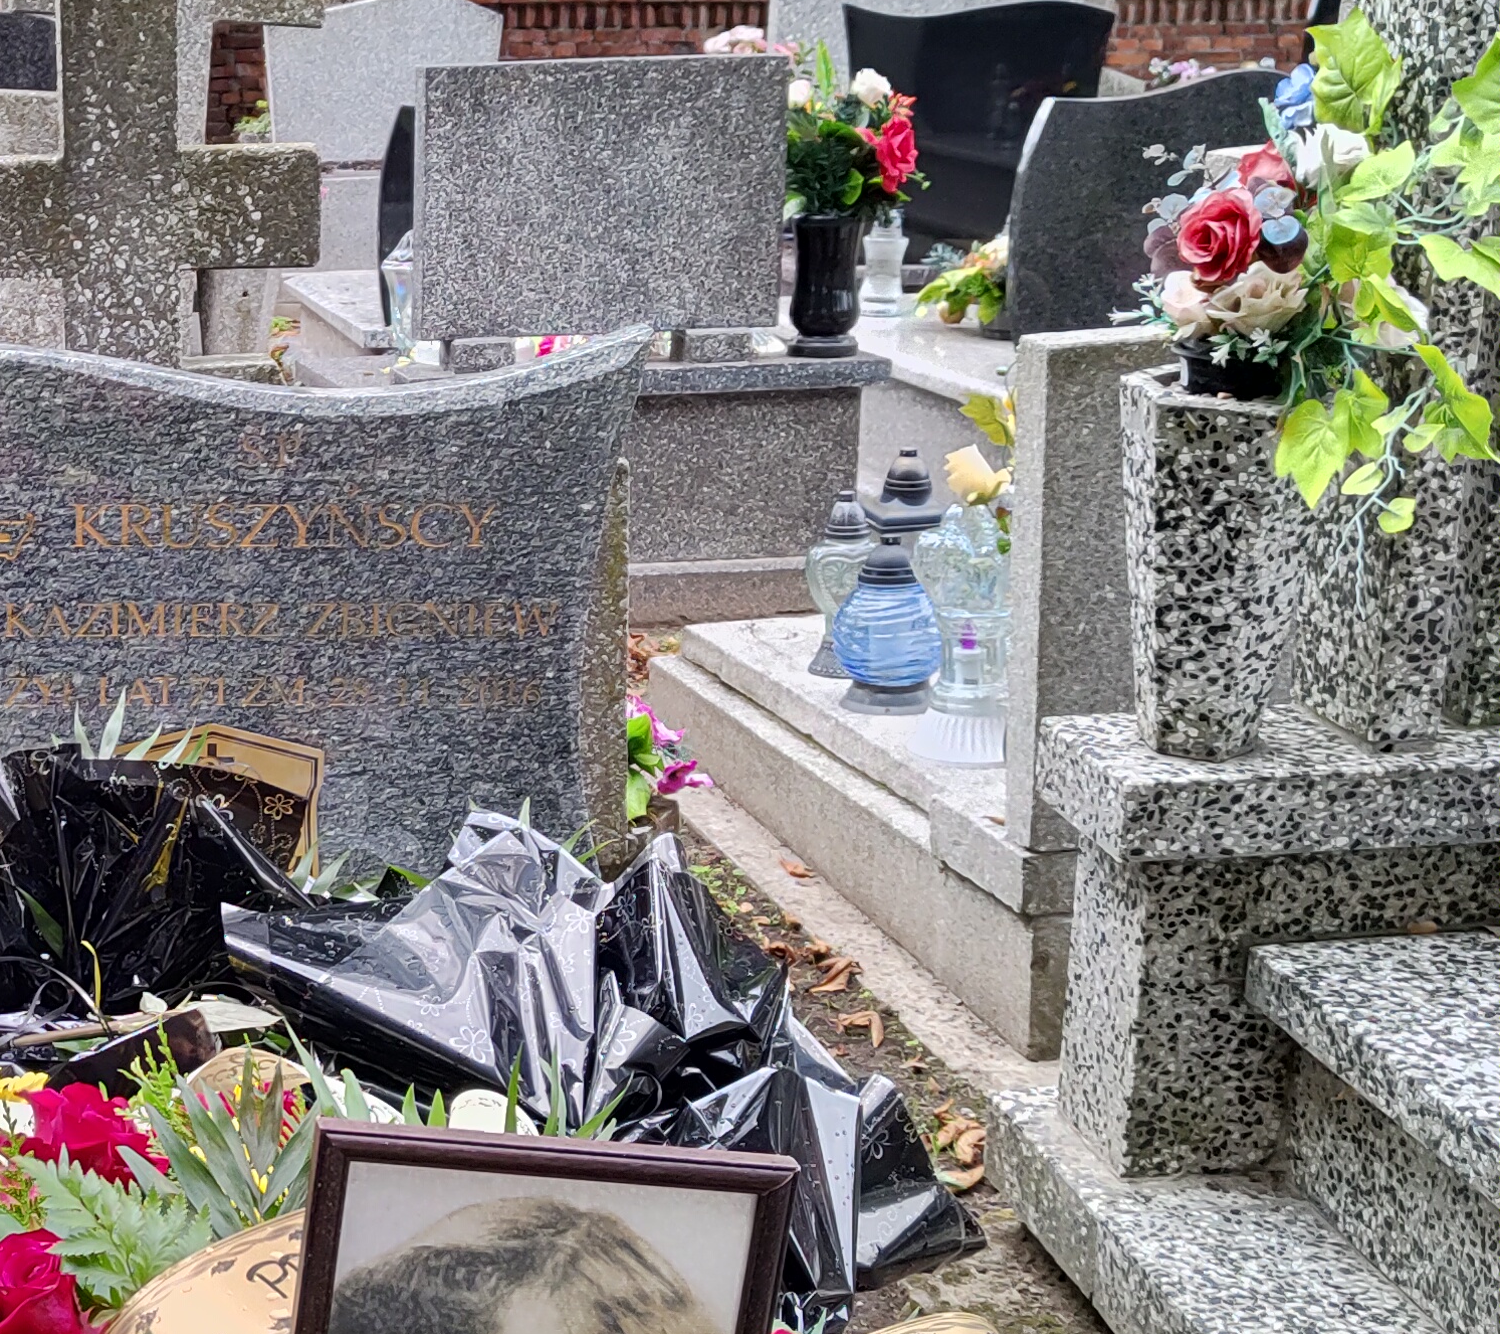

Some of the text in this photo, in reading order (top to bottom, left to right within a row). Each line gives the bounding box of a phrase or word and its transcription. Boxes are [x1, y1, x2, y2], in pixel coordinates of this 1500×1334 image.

[71, 485, 496, 549] KRUSZYŃSCY
[3, 599, 560, 640] KAZIMIERZ ZBIGNIEW
[99, 675, 177, 708] LAT
